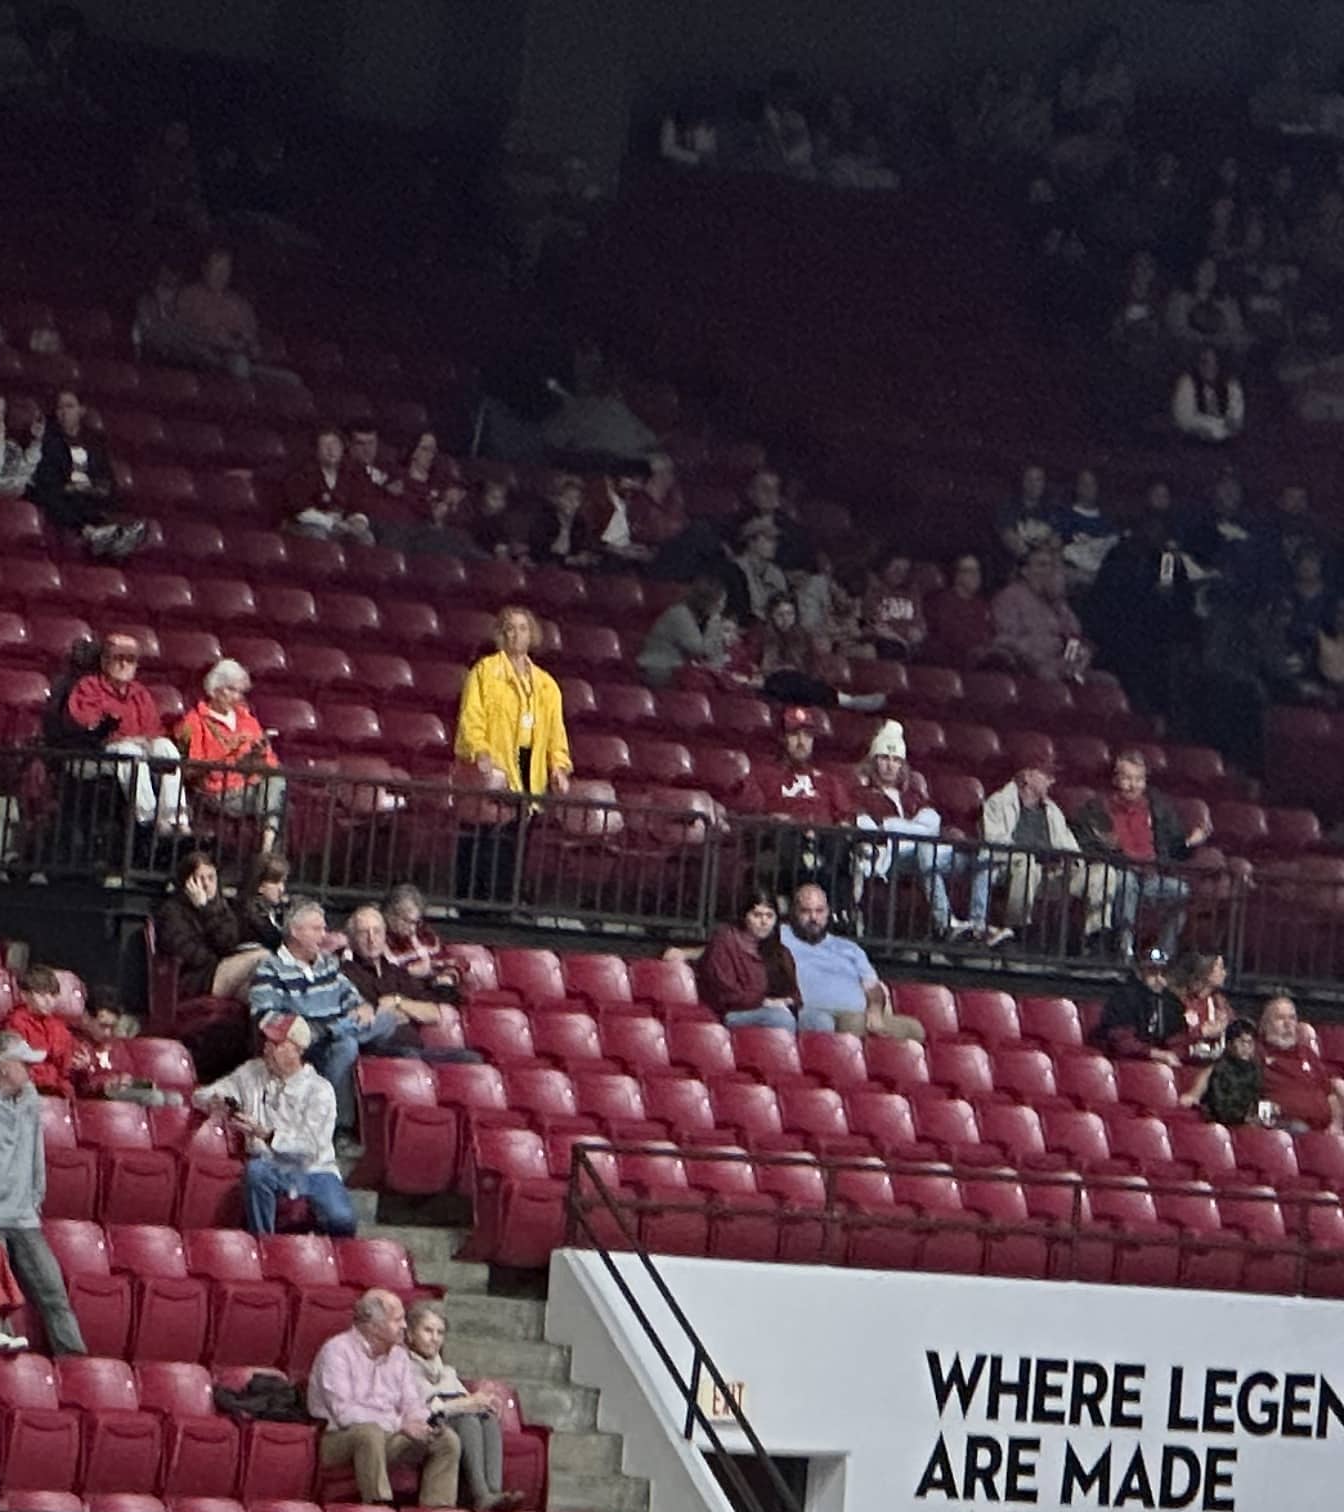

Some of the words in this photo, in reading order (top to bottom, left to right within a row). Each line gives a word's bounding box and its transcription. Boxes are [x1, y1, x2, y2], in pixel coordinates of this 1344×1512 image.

[925, 1349, 1146, 1429] WHERE
[913, 1431, 1040, 1503] ARE
[1059, 1439, 1238, 1512] MADE
